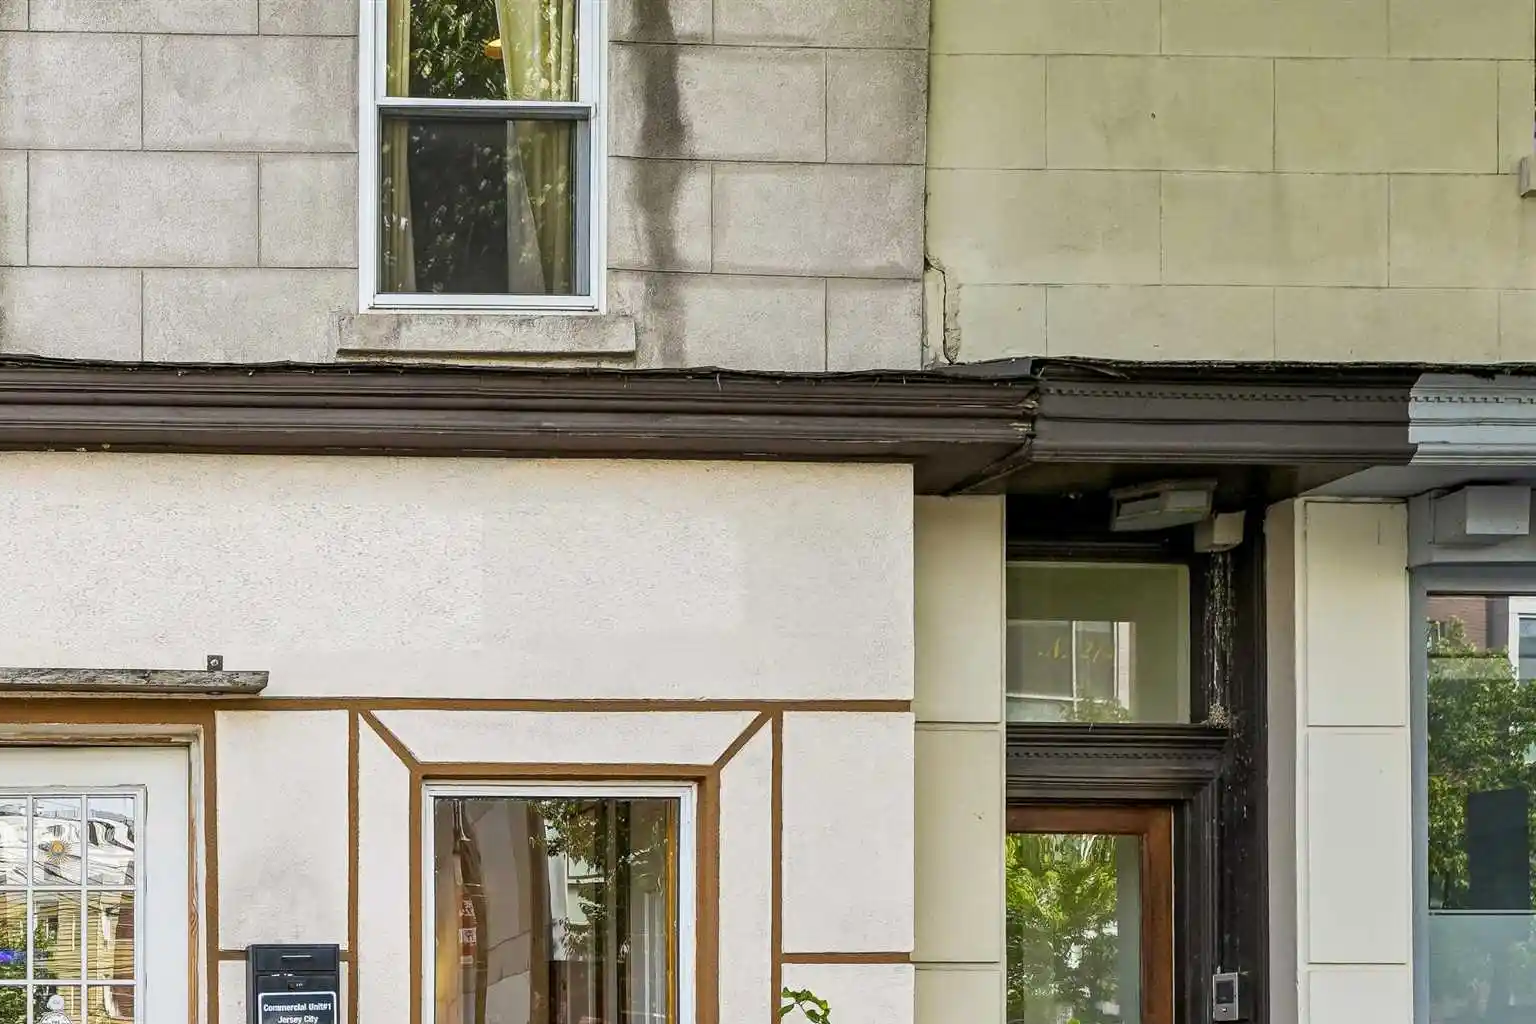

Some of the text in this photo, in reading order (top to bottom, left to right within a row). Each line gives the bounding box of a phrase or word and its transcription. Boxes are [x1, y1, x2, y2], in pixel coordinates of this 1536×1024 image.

[263, 1003, 307, 1012] Commercial
[277, 1014, 319, 1024] Jersey City
